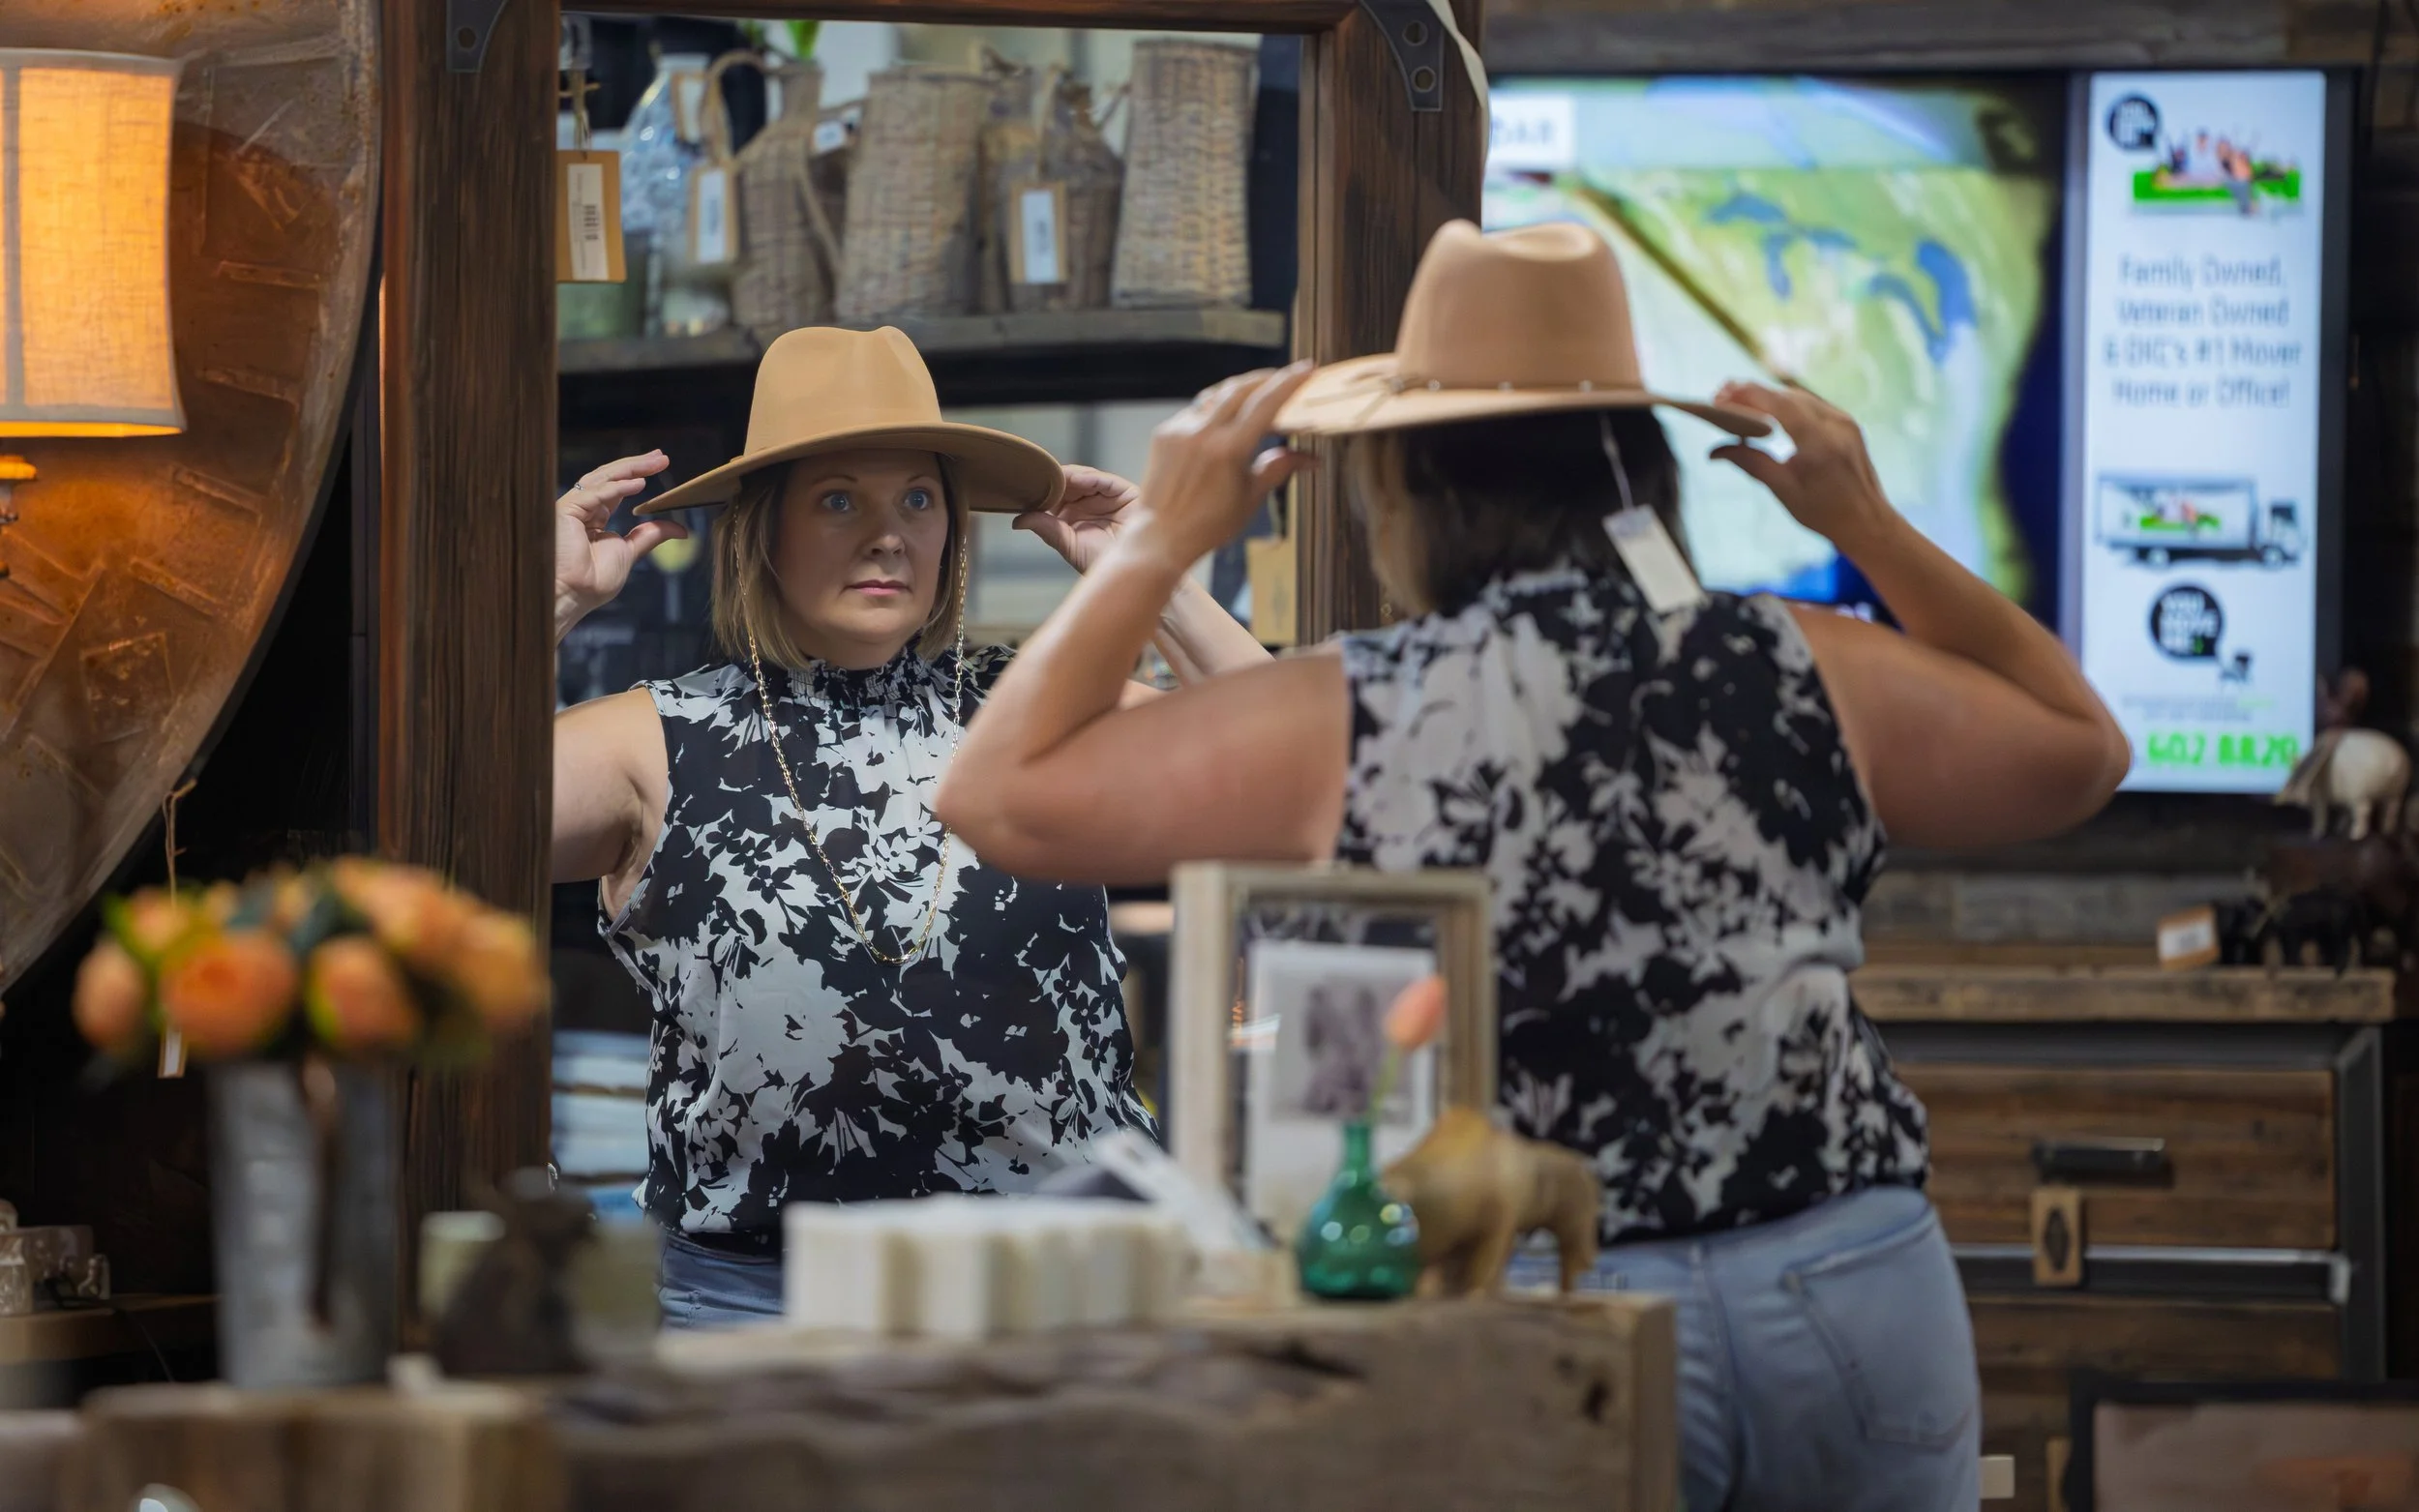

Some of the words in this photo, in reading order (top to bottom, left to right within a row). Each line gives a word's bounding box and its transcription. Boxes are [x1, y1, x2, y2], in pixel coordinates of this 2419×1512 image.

[2118, 254, 2194, 290] Family
[2116, 298, 2203, 327] Veteran
[2210, 294, 2289, 327] Owned
[2229, 336, 2302, 368] Mover
[2111, 376, 2179, 407] Home
[2147, 731, 2206, 768] 602
